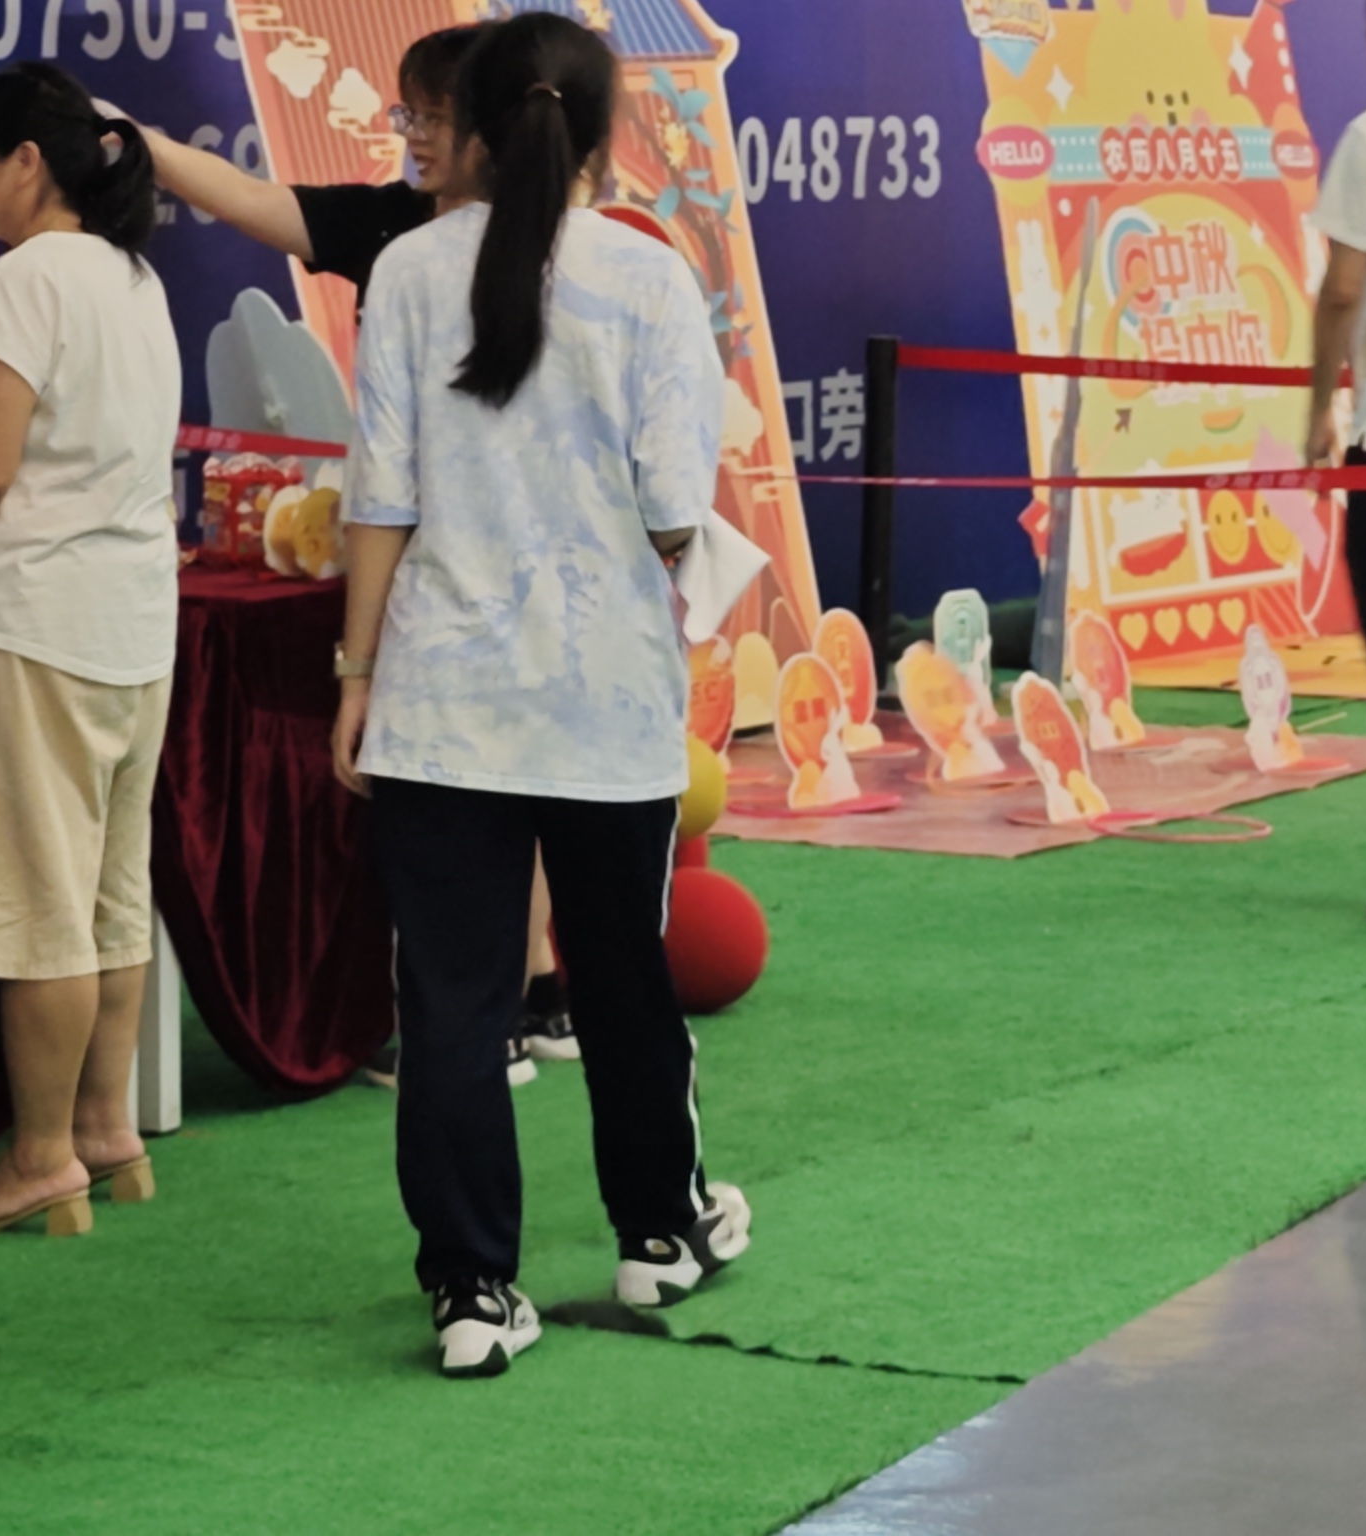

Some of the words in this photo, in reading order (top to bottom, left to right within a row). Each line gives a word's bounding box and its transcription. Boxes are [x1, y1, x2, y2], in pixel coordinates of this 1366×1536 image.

[988, 140, 1045, 166] HELLO
[1103, 137, 1238, 174] 农历八月十五
[1147, 221, 1237, 300] 中秋
